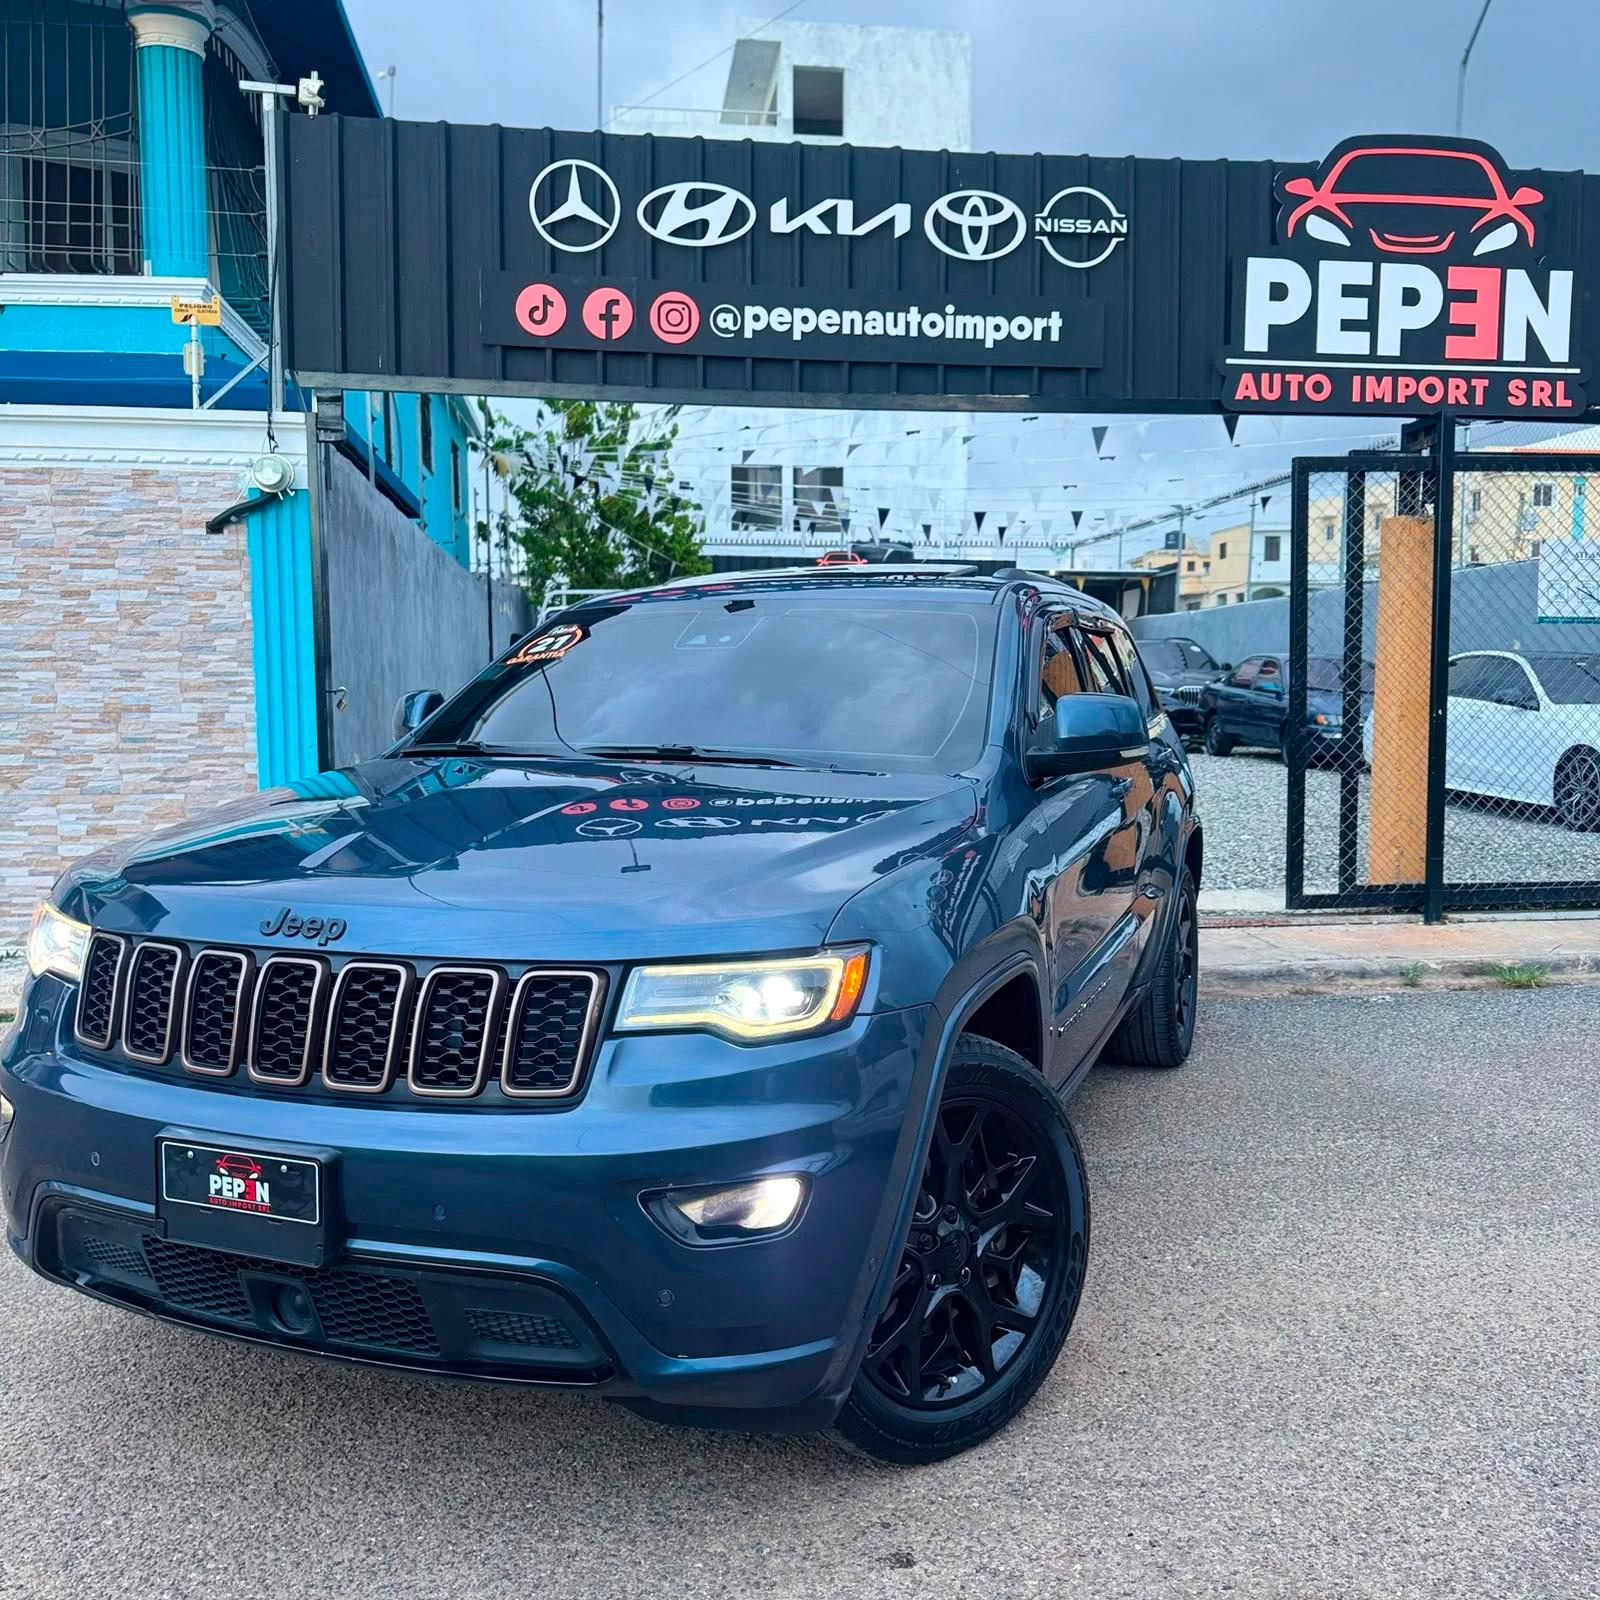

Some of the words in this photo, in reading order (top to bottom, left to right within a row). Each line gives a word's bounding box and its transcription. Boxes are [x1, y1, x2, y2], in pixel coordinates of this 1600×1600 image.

[770, 197, 911, 239] KIA
[1035, 217, 1128, 234] NISSAN
[709, 303, 1063, 349] @pepenautoimport
[1244, 256, 1574, 363] PEPEN
[1235, 372, 1332, 402] AUTO
[1352, 375, 1489, 406] IMPORT
[1507, 379, 1573, 407] SRL
[259, 907, 347, 947] Jeep
[208, 1197, 227, 1206] AUTO
[229, 1200, 256, 1210] IMPORT
[209, 1174, 270, 1203] PEPEN
